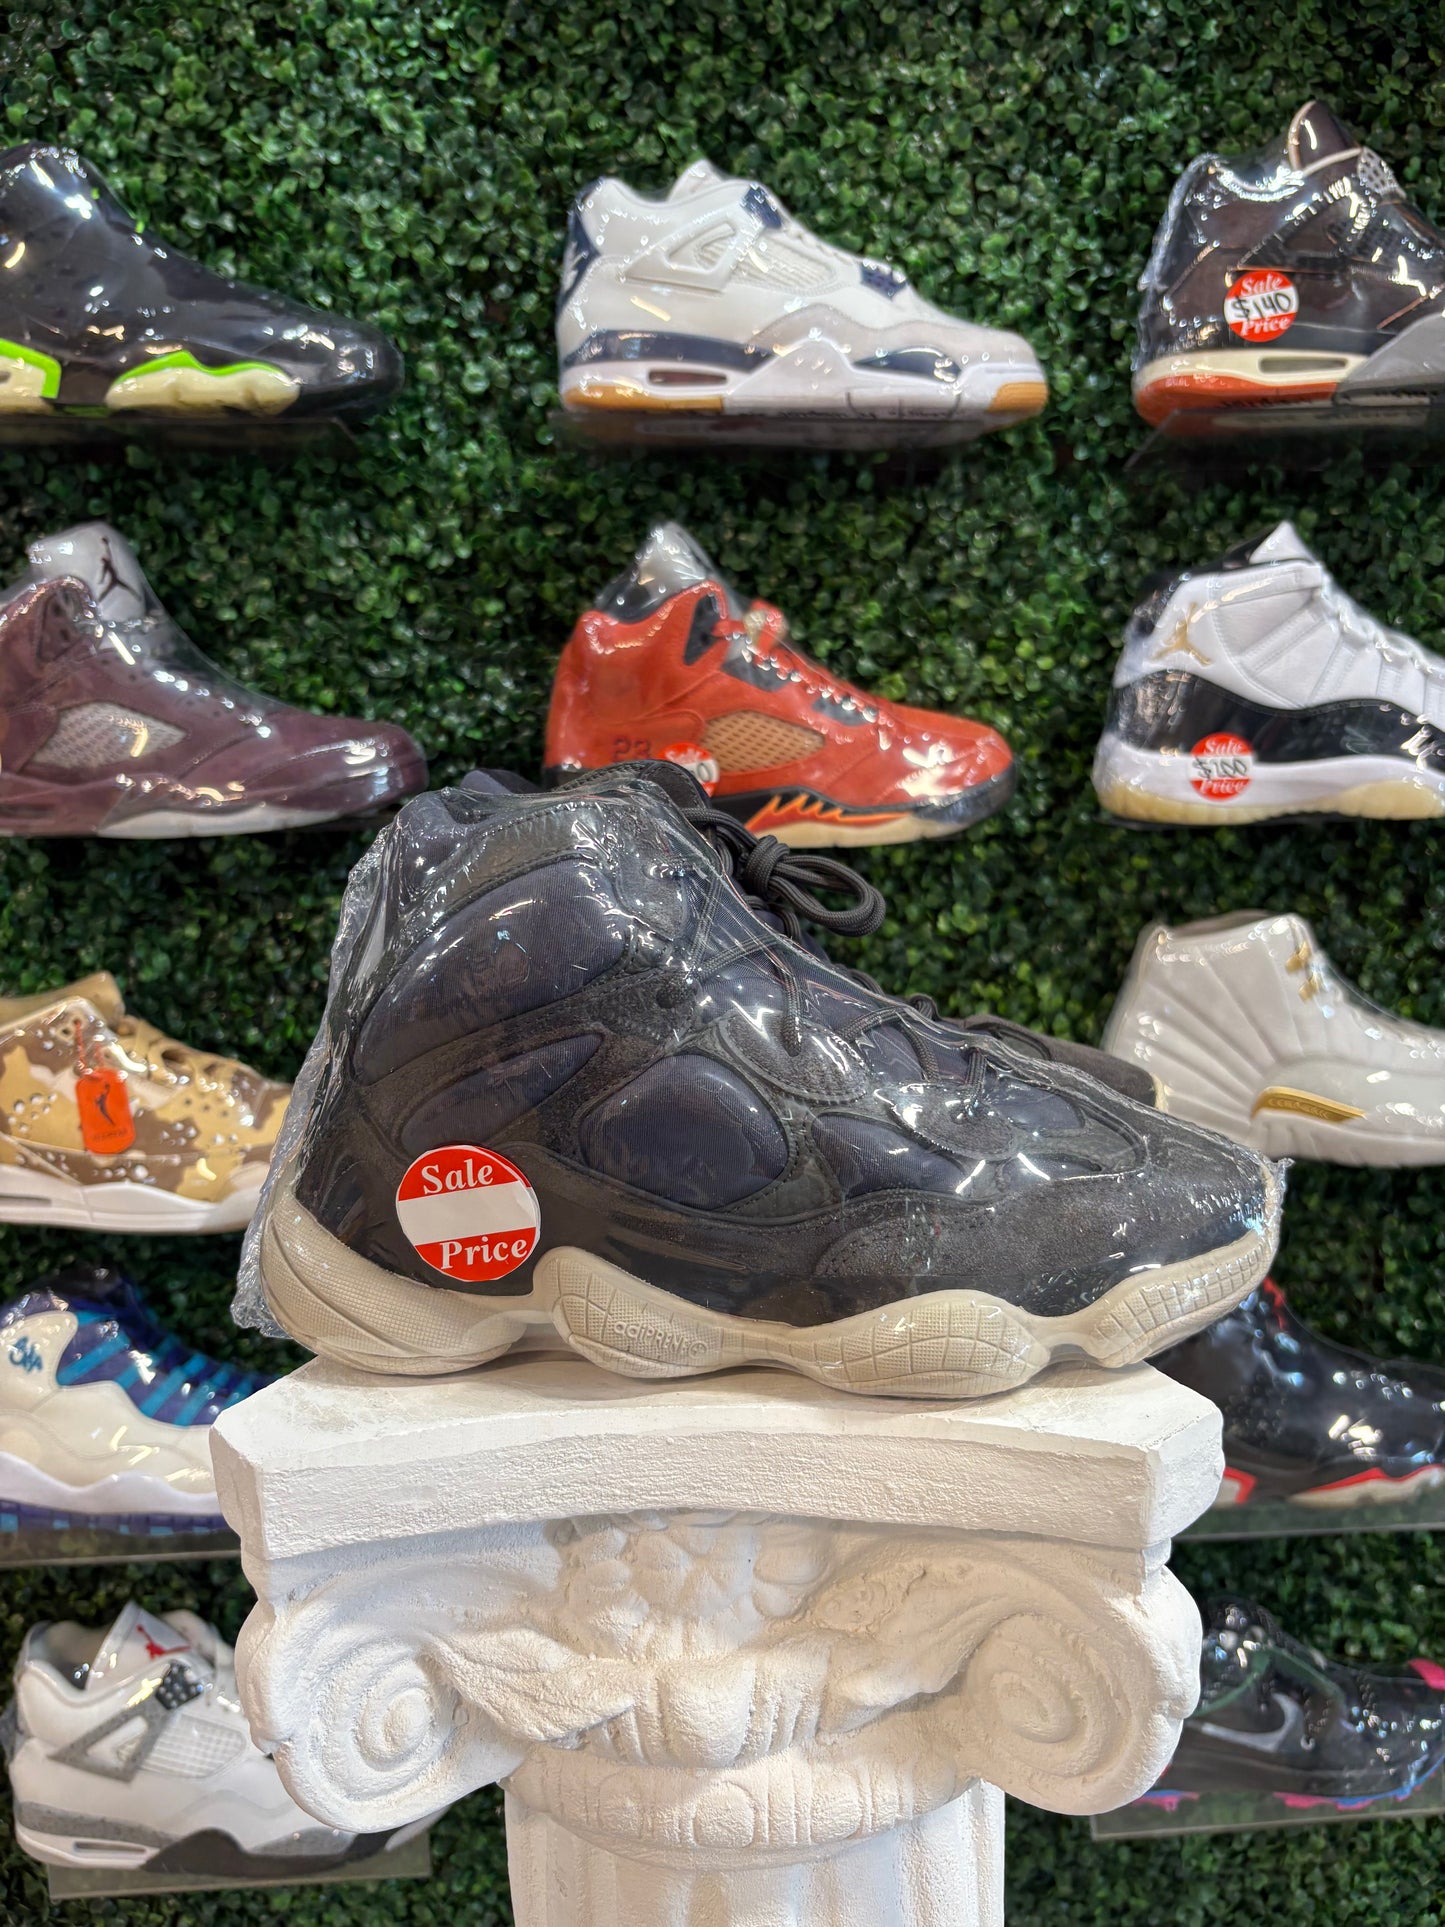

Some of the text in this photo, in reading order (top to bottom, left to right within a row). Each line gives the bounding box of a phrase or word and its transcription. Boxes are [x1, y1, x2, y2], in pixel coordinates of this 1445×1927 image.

[1240, 273, 1283, 297] Sale
[1231, 292, 1292, 320] $140
[1240, 316, 1290, 337] Price
[1203, 739, 1243, 757] Sale
[1199, 779, 1245, 794] Price
[421, 1158, 494, 1195] Sale
[439, 1235, 528, 1270] Price
